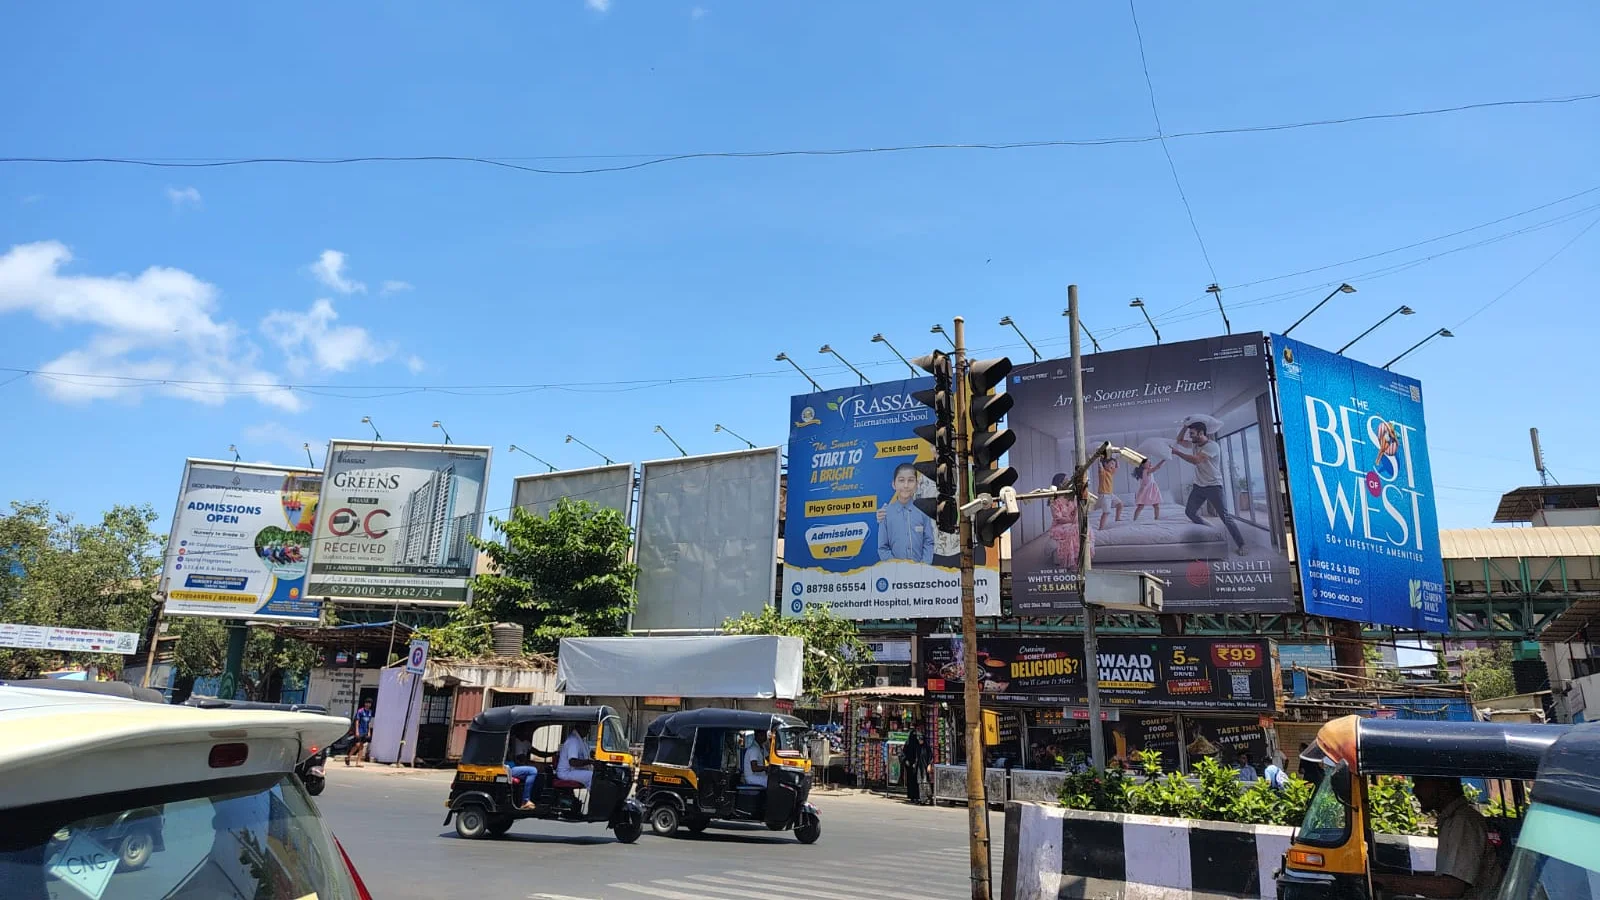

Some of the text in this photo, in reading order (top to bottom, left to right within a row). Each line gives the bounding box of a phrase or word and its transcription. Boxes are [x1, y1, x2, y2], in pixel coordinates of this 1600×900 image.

[1053, 379, 1212, 408] Arre Sooner. Live Finer.
[1136, 397, 1170, 405] POSSESSION
[1350, 396, 1369, 409] THE
[854, 411, 928, 428] International School
[812, 440, 827, 452] The
[1306, 395, 1416, 488] BEST
[881, 444, 919, 453] ICSE Board
[811, 448, 863, 468] START TO
[810, 466, 854, 484] A BRIGHT
[1368, 479, 1379, 490] OF
[188, 502, 262, 515] ADMISSIONS
[809, 501, 873, 514] Play Group to XII
[1312, 465, 1425, 551] WEST
[207, 514, 239, 524] OPEN
[811, 528, 863, 542] Admissions
[324, 542, 386, 554] RECEIVED
[823, 544, 848, 556] Open
[1326, 534, 1423, 562] 50+ LIFESTYLE AMENITIES
[1213, 560, 1271, 571] SRISHTI
[1308, 559, 1360, 576] LARGE 2 & 3 BED
[892, 578, 987, 589] rassazschoolm
[1216, 573, 1272, 583] NAMAAH
[1324, 573, 1340, 582] HOMES
[340, 586, 442, 597] 77000 27862/3/4
[806, 582, 866, 593] 88798 65554
[826, 596, 959, 608] Wockhardt Hospital, Mira Road
[1320, 590, 1363, 604] 7090 400 300
[1173, 650, 1185, 665] 5
[1217, 648, 1256, 661] ₹99
[1011, 659, 1078, 678] DELICIOUS?
[1098, 668, 1154, 682] HAVAN
[1217, 726, 1240, 735] TASTE
[66, 853, 107, 875] CNG
